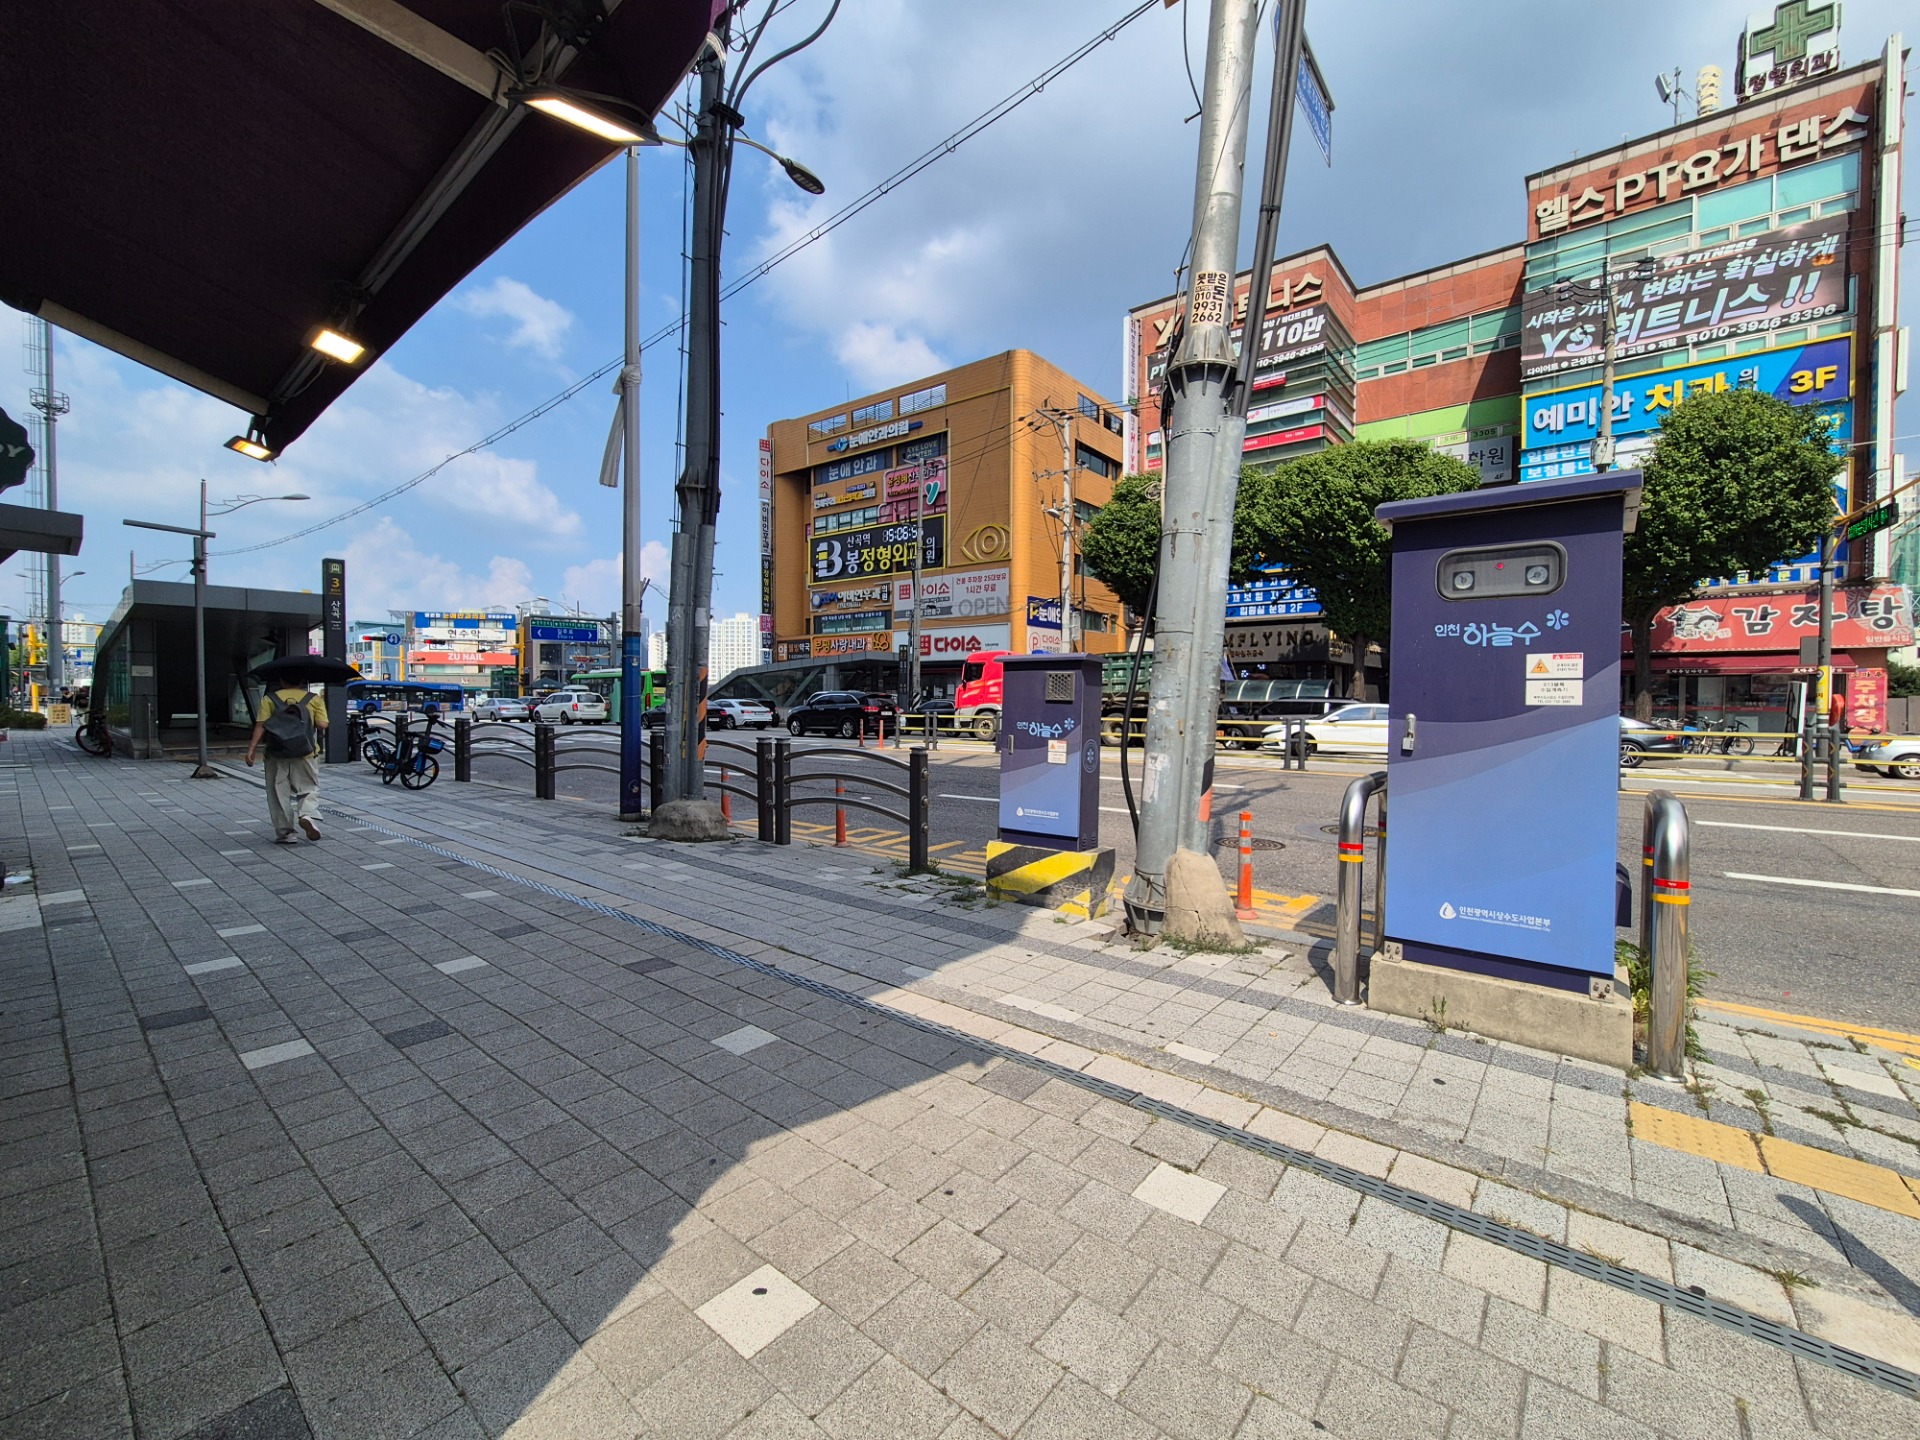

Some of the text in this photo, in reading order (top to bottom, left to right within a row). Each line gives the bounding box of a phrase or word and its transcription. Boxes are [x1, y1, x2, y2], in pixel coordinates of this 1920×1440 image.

[1536, 185, 1606, 233] 헬스
[1777, 106, 1869, 162] 댄스
[1687, 239, 1758, 264] FITNESS
[1526, 306, 1576, 328] 시작은
[1642, 264, 1717, 303] 변화는
[1723, 235, 1840, 280] 확실하게
[1195, 292, 1211, 301] 010
[1212, 285, 1226, 302] 돈
[1193, 301, 1223, 312] 9931
[1192, 312, 1222, 323] 2662
[1699, 304, 1838, 340] 010-3946-8396
[1541, 324, 1596, 358] YS
[1527, 363, 1559, 376] 다이어트
[1570, 355, 1596, 367] 근성장
[1533, 391, 1635, 432] 예미안
[1790, 365, 1838, 393] 3F
[760, 458, 770, 489] 다이소
[846, 533, 871, 548] 산곡역
[331, 577, 340, 588] 3
[984, 584, 996, 592] 무료
[959, 595, 1009, 616] OPEN
[1290, 602, 1303, 613] 2F
[1733, 597, 1904, 634] 감자탕
[934, 635, 981, 652] 다이소
[1042, 635, 1060, 644] 다이소
[1435, 621, 1542, 647] 인천 하늘수
[1854, 680, 1878, 723] 주차장
[1029, 722, 1063, 738] 하늘수
[1459, 906, 1551, 927] 인천광역시상수도사업본부
